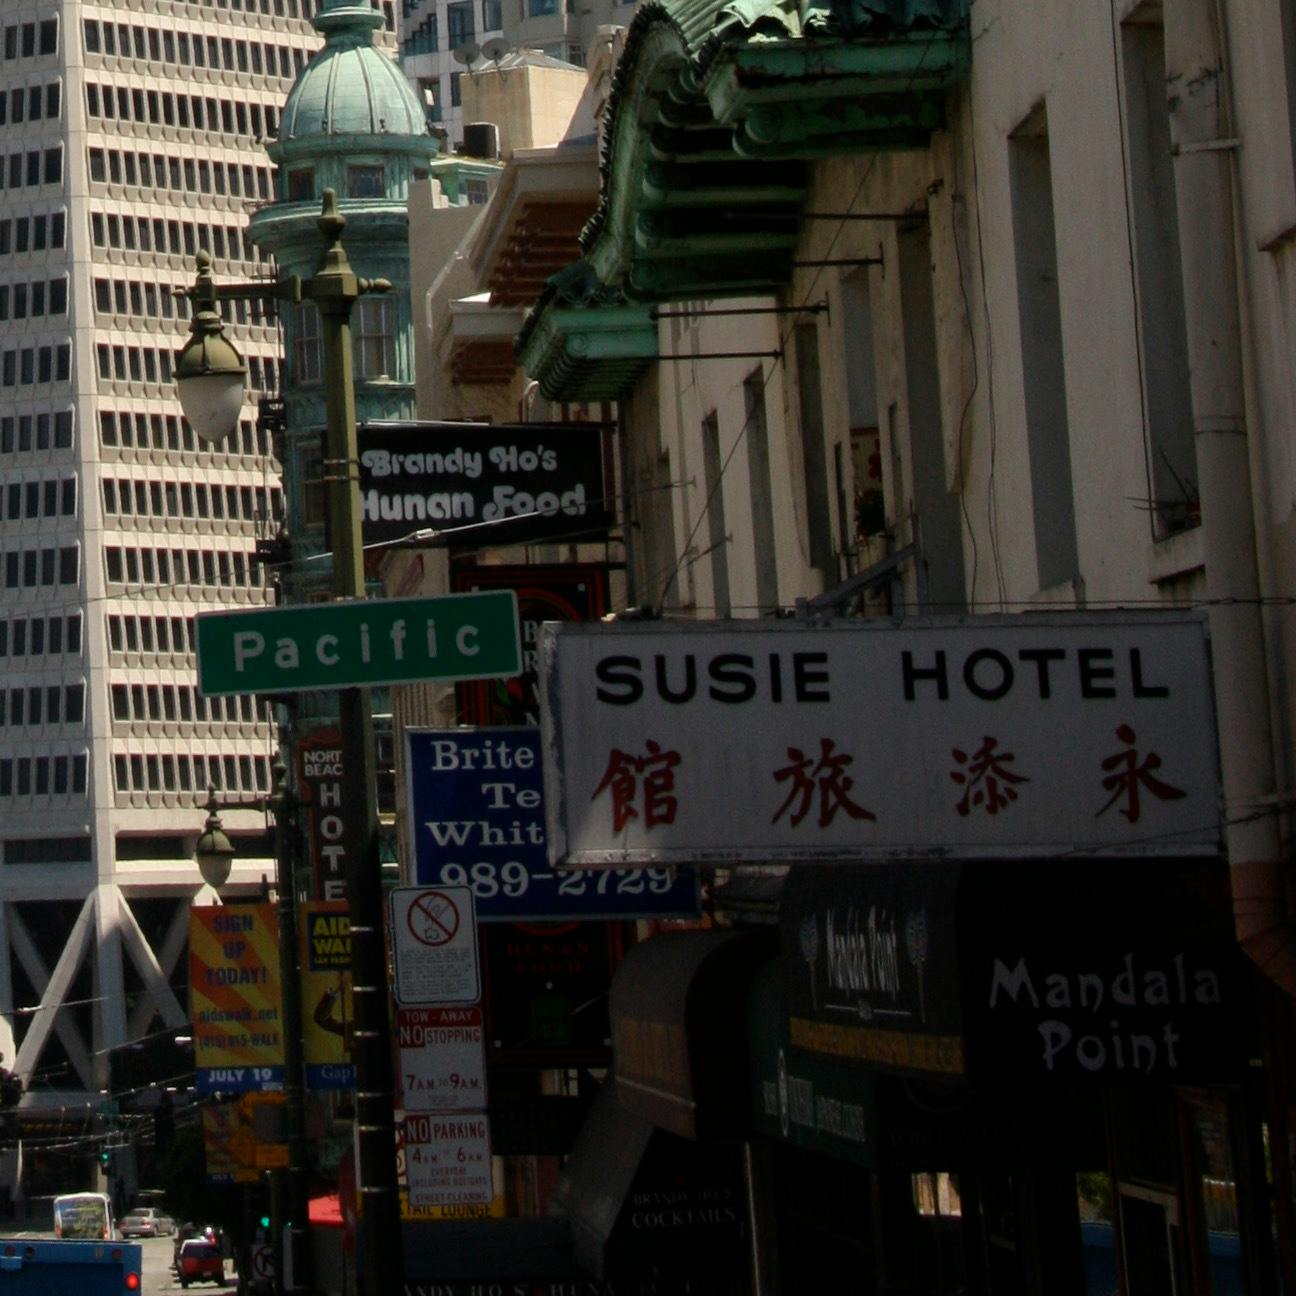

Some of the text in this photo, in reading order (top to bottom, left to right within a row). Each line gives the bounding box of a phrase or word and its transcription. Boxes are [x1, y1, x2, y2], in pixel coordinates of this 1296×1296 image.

[361, 445, 558, 478] Brandy Ho's
[360, 483, 586, 525] Hunan Food
[233, 618, 481, 672] Pacific
[596, 648, 1169, 704] SUSIE HOTEL
[431, 740, 534, 770] Brite
[439, 862, 672, 898] 989-2729
[213, 914, 253, 932] SIGN
[223, 940, 246, 959] UP
[206, 967, 266, 985] TODAY!
[988, 952, 1223, 1013] Mandala
[405, 1010, 473, 1023] TOW AWAY
[400, 1025, 480, 1045] NO STOPPING
[1037, 1019, 1181, 1076] Point
[208, 1068, 272, 1082] JULY 19
[321, 1065, 351, 1083] Gap
[407, 1118, 485, 1142] NO PARKING
[632, 1207, 735, 1228] COCKTAILS
